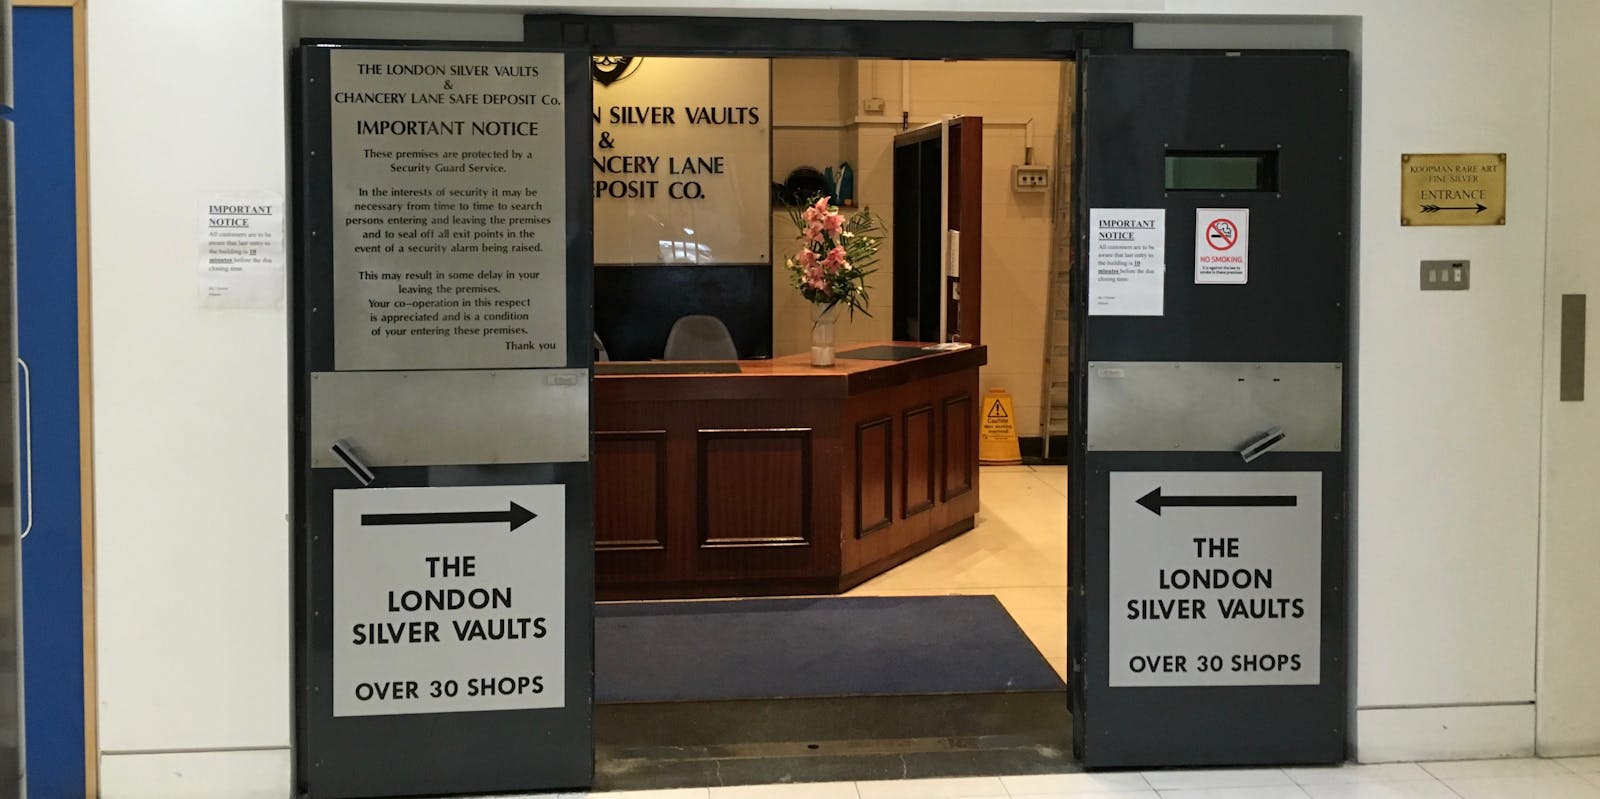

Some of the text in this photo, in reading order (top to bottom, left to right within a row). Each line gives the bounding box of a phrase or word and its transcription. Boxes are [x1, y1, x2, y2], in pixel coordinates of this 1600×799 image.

[358, 64, 538, 77] THE LONDON SILVER VAULTS
[444, 80, 453, 90] &
[335, 92, 560, 105] CHANCERY LANE SAFE DEPOSIT Co.
[610, 106, 675, 124] SILVER
[685, 107, 759, 125] VAULTS
[357, 121, 538, 136] IMPORTANT NOTICE
[598, 131, 614, 150] &
[363, 149, 392, 158] These
[396, 149, 439, 160] premises
[462, 149, 508, 160] protected
[512, 149, 522, 160] by
[390, 163, 506, 174] Security Guard Service.
[1410, 165, 1497, 174] KOOPMAN RARE ART
[359, 187, 537, 199] In the interests of security it may be
[593, 181, 659, 199] POSIT
[1421, 189, 1486, 200] ENTRANCE
[209, 205, 272, 215] IMPORTANT
[355, 204, 403, 212] necessary
[407, 201, 430, 210] from
[434, 202, 455, 210] time
[473, 202, 494, 211] time
[511, 201, 542, 210] search
[209, 218, 249, 228] NOTICE
[346, 215, 551, 227] persons entering and leaving the premises
[1099, 220, 1155, 229] IMPORTANT
[363, 229, 381, 238] and
[398, 229, 417, 238] seal
[420, 229, 434, 238] off
[438, 229, 449, 238] all
[453, 229, 470, 238] exit
[474, 229, 504, 240] points
[507, 229, 516, 238] in
[520, 229, 535, 238] the
[1099, 232, 1134, 241] NOTICE
[354, 245, 380, 253] event
[385, 244, 394, 252] of
[408, 243, 447, 254] security
[451, 243, 478, 252] alarm
[482, 243, 508, 254] being
[512, 243, 543, 252] raised.
[358, 271, 378, 280] This
[382, 273, 401, 281] may
[405, 270, 432, 279] result
[436, 271, 445, 279] in
[477, 270, 502, 280] delay
[506, 270, 515, 279] in
[519, 272, 540, 280] your
[399, 284, 500, 295] leaving the premises.
[369, 299, 390, 308] Your
[462, 298, 471, 307] in
[475, 298, 492, 307] this
[495, 299, 530, 309] respect
[370, 313, 377, 322] is
[381, 312, 438, 324] appreciated
[442, 312, 460, 321] and
[464, 312, 471, 320] is
[484, 311, 528, 320] condition
[371, 326, 528, 337] of your entering these premises.
[505, 341, 556, 352] Thank you
[1193, 538, 1239, 558] THE
[426, 556, 475, 578] THE
[1160, 569, 1272, 589] LONDON
[389, 587, 511, 612] LONDON
[1127, 598, 1304, 620] SILVER VAULTS
[353, 617, 546, 645] SILVER VAULTS
[1129, 654, 1301, 673] OVER 30 SHOPS
[355, 676, 543, 701] OVER 30 SHOPS
